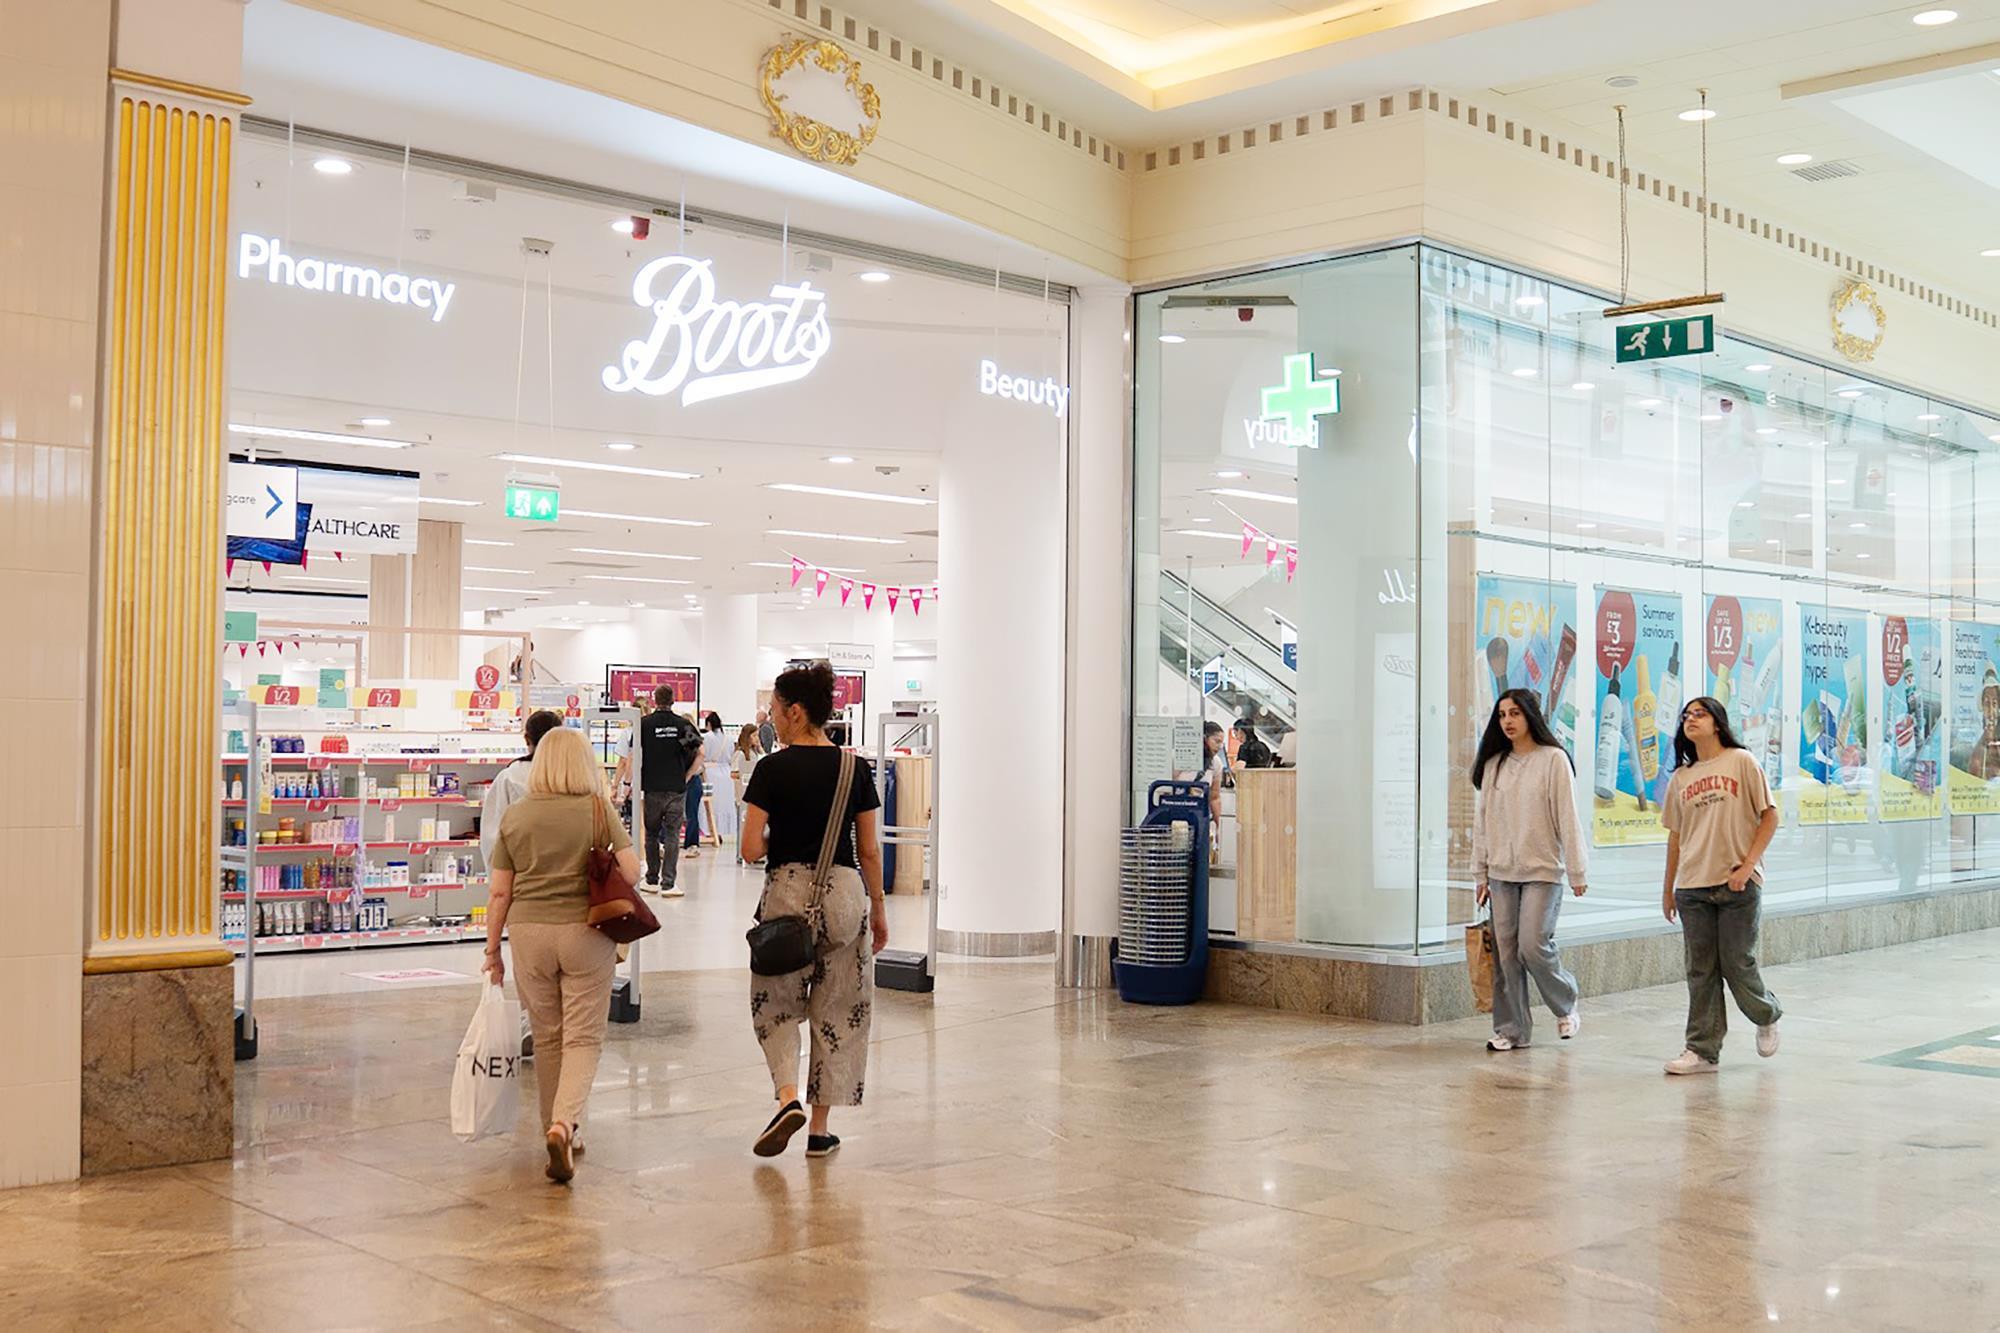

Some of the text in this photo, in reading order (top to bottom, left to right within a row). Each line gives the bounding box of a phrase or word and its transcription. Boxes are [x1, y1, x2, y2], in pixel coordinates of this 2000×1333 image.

[238, 232, 456, 323] Pharmacy
[602, 255, 831, 407] Boots
[980, 360, 1070, 418] Beauty
[306, 519, 401, 540] ALTHCARE
[1482, 596, 1557, 638] new
[1606, 611, 1622, 619] FROM
[1642, 604, 1675, 621] Summer
[1716, 609, 1729, 617] SAVE
[1606, 620, 1621, 645] £3
[1642, 624, 1675, 639] saviours
[1713, 625, 1732, 649] 1/3
[1804, 615, 1848, 642] K-beauty
[1955, 628, 1981, 643] Summer
[1804, 639, 1849, 659] worth the
[1886, 633, 1901, 654] 1/2
[1804, 659, 1828, 685] hype
[1954, 662, 1976, 675] sorted
[274, 689, 290, 700] 1/2
[376, 693, 392, 704] 1/2
